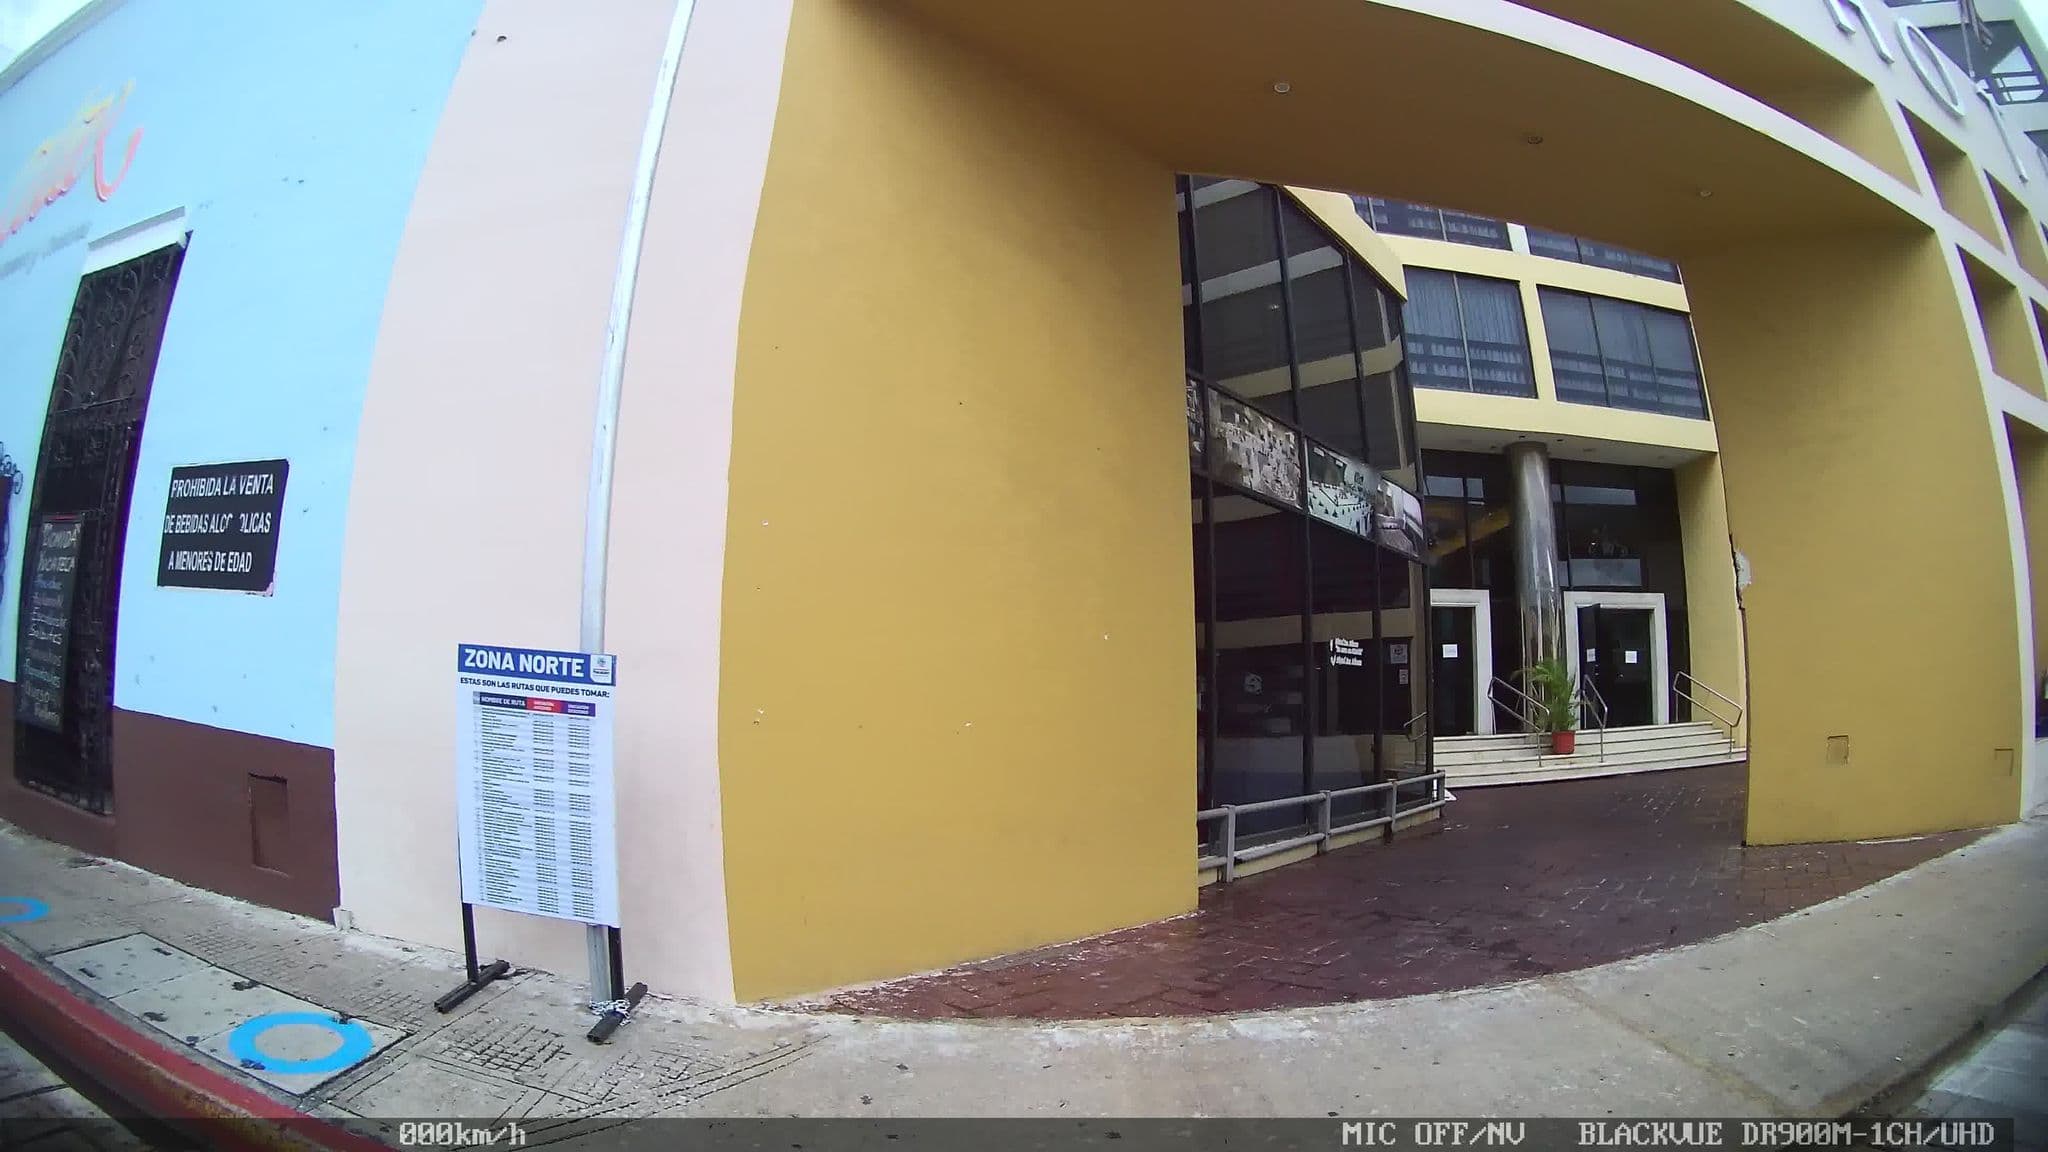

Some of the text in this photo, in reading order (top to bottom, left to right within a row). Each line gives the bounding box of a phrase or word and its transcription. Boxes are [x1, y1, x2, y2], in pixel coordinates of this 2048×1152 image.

[170, 473, 274, 498] PROHIBIDA LA VENTA
[164, 514, 176, 534] DE
[175, 513, 210, 534] BEBIDAS
[167, 550, 253, 573] A MENORES DE EDAD
[464, 648, 585, 678] ZONA NORTE
[460, 677, 610, 698] ESTAS SON LAS RUTAS QUE PUEDES TOMAR:
[481, 696, 503, 705] NOMBRE
